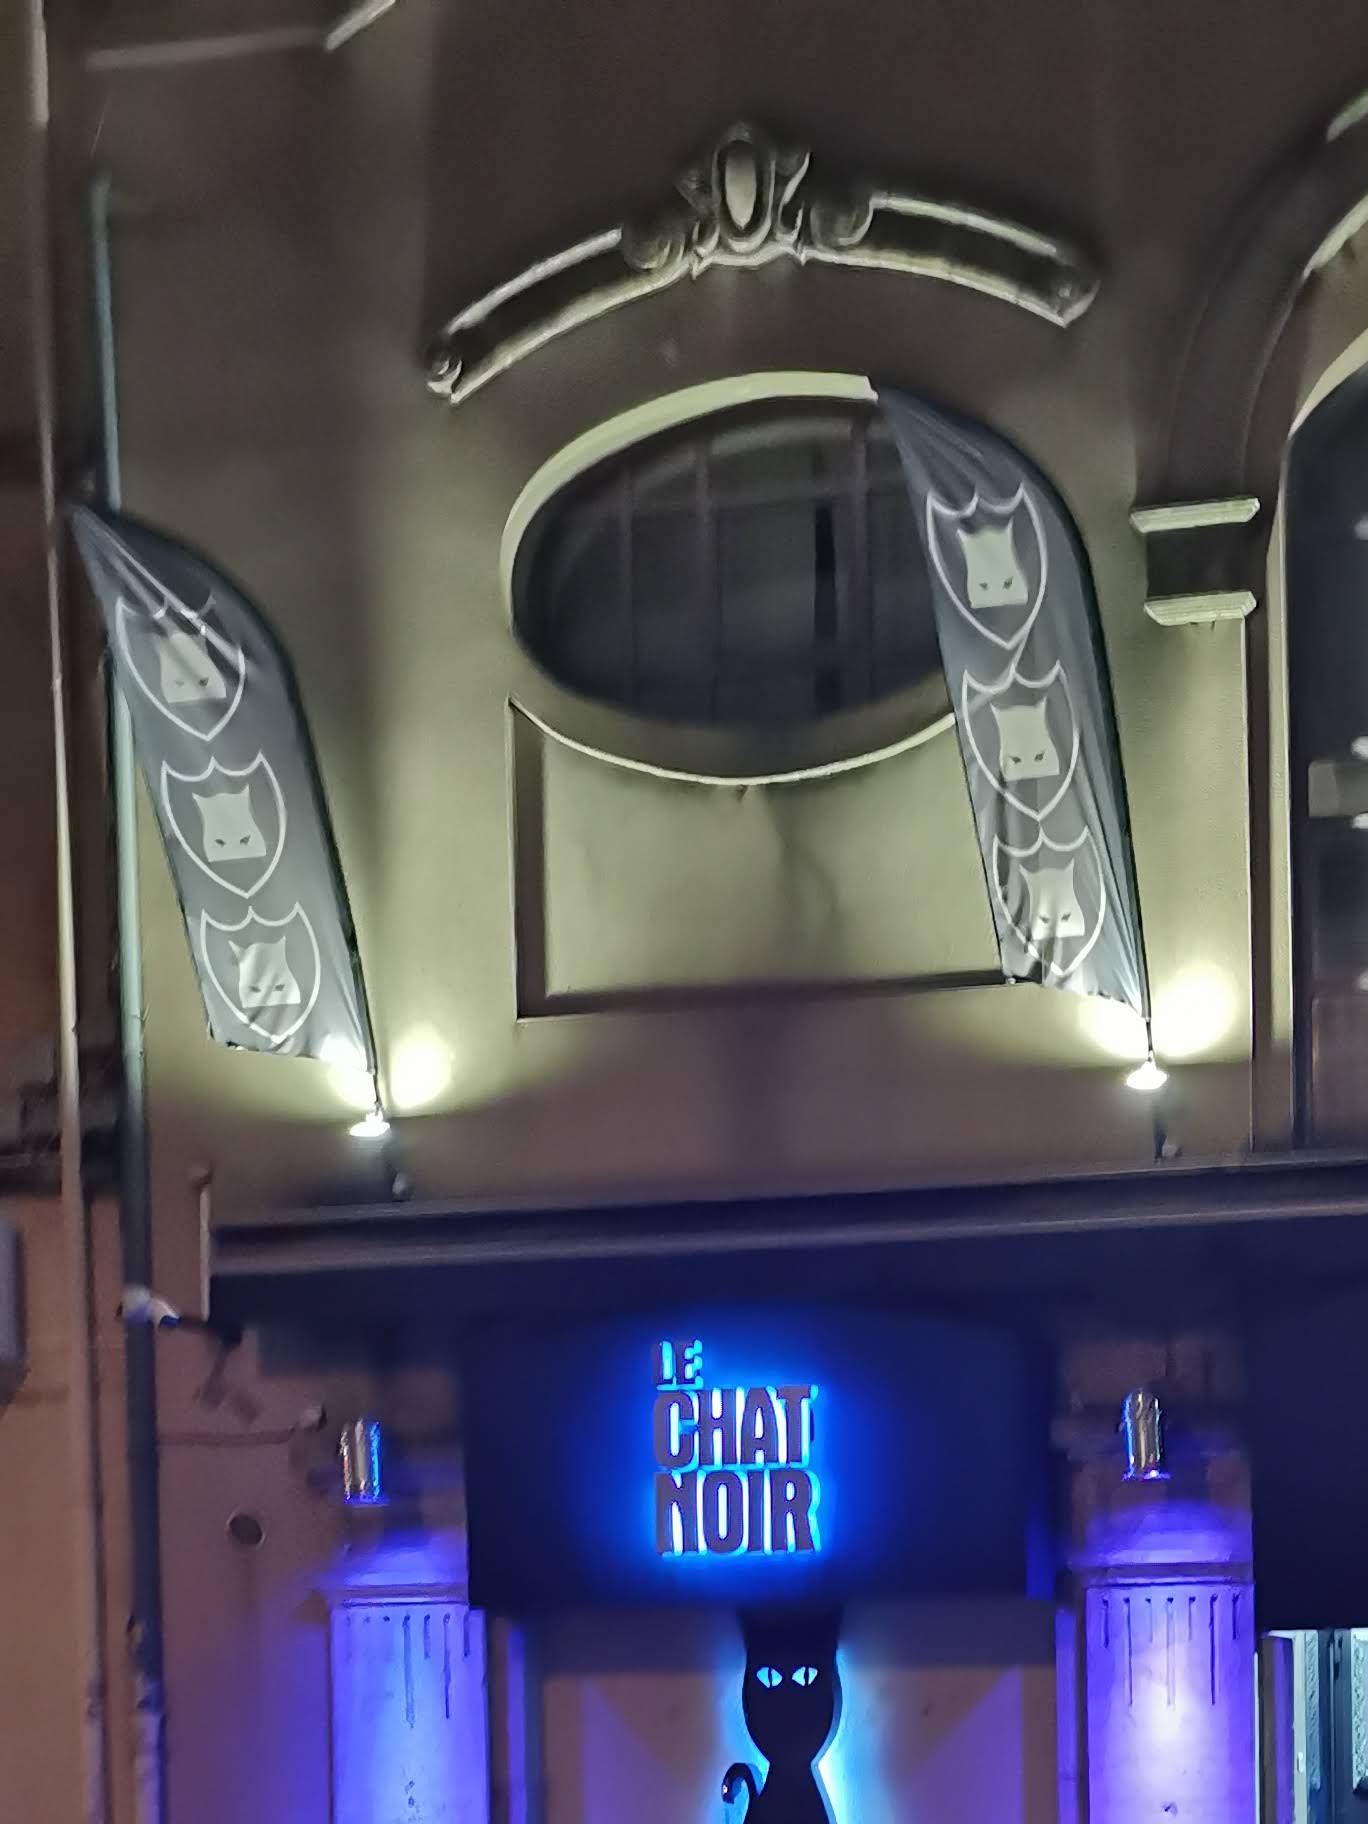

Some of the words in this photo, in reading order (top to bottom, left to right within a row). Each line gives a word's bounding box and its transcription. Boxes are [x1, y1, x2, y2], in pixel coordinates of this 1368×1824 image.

[653, 1339, 702, 1386] LE
[654, 1384, 816, 1470] CHAT
[655, 1469, 819, 1555] NOIR
